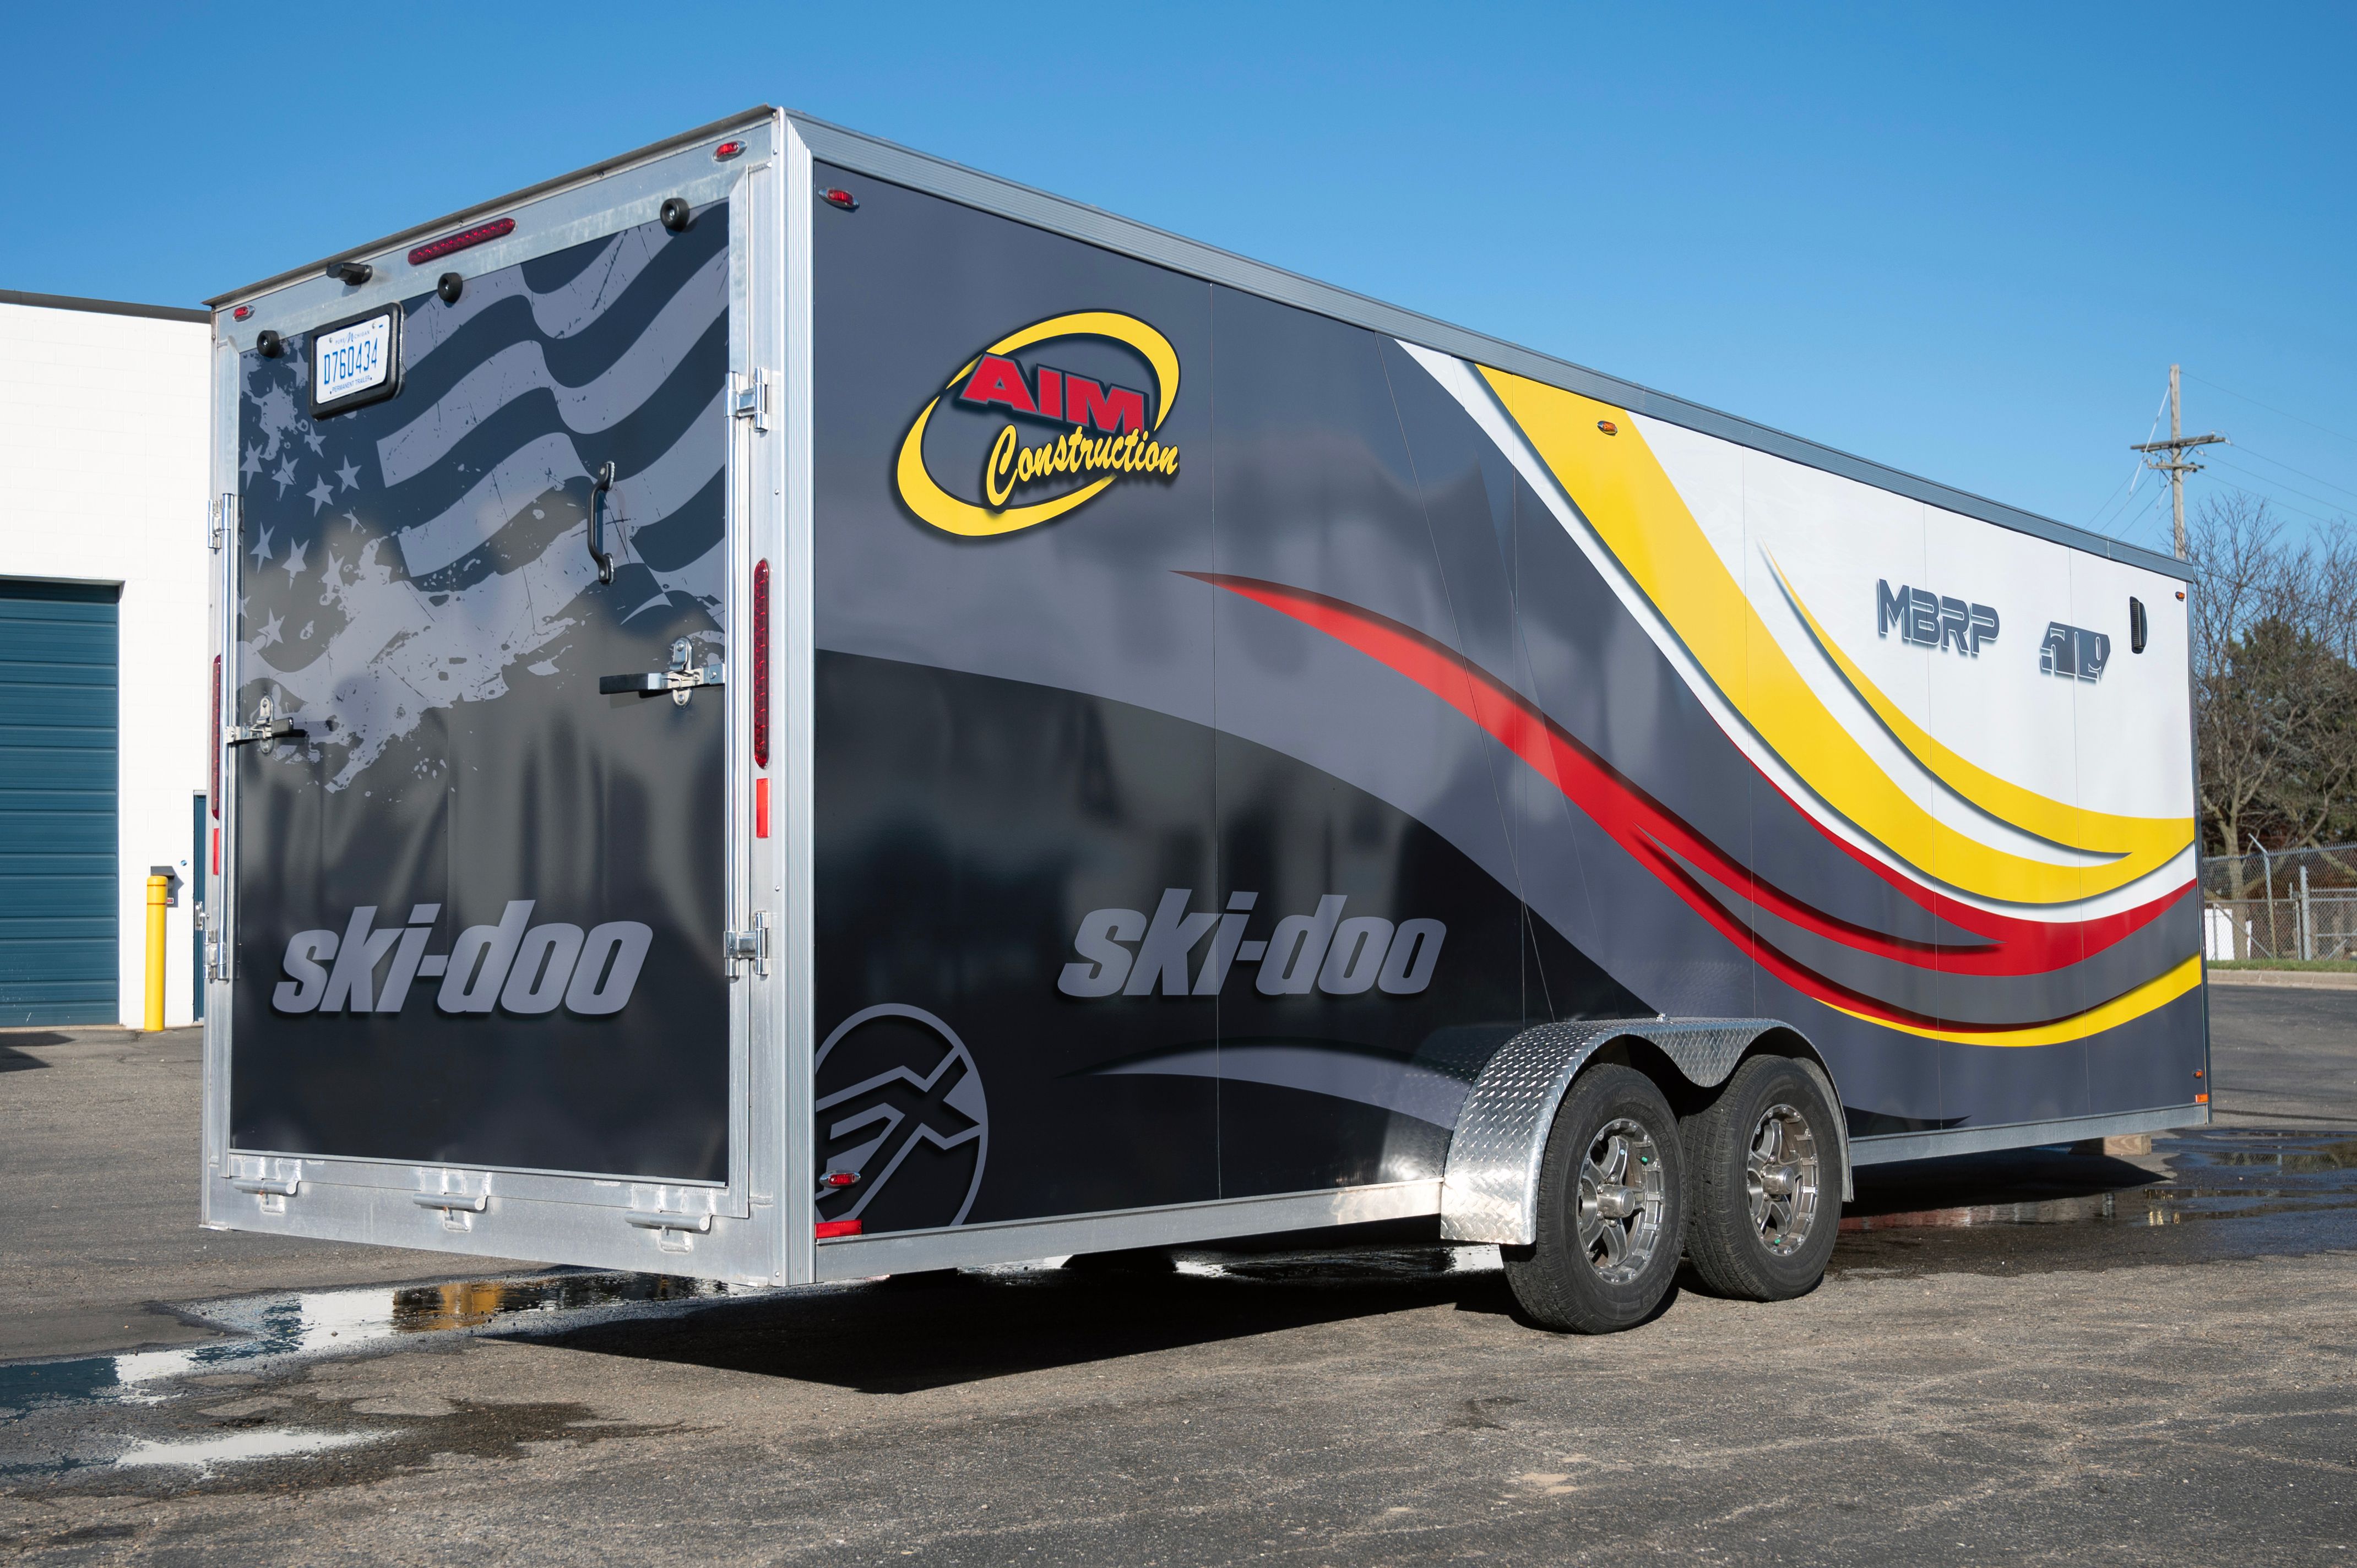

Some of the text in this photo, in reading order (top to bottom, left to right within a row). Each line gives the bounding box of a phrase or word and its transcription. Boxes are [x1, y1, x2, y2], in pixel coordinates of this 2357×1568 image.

[324, 337, 378, 385] D760434
[332, 375, 371, 392] PERMANENT TRAILER
[958, 353, 1145, 435] AIM
[986, 424, 1178, 506] Construction
[1878, 578, 2000, 654] MBRP
[272, 899, 653, 1015] ski-doo
[1057, 888, 1447, 998] ski-doo
